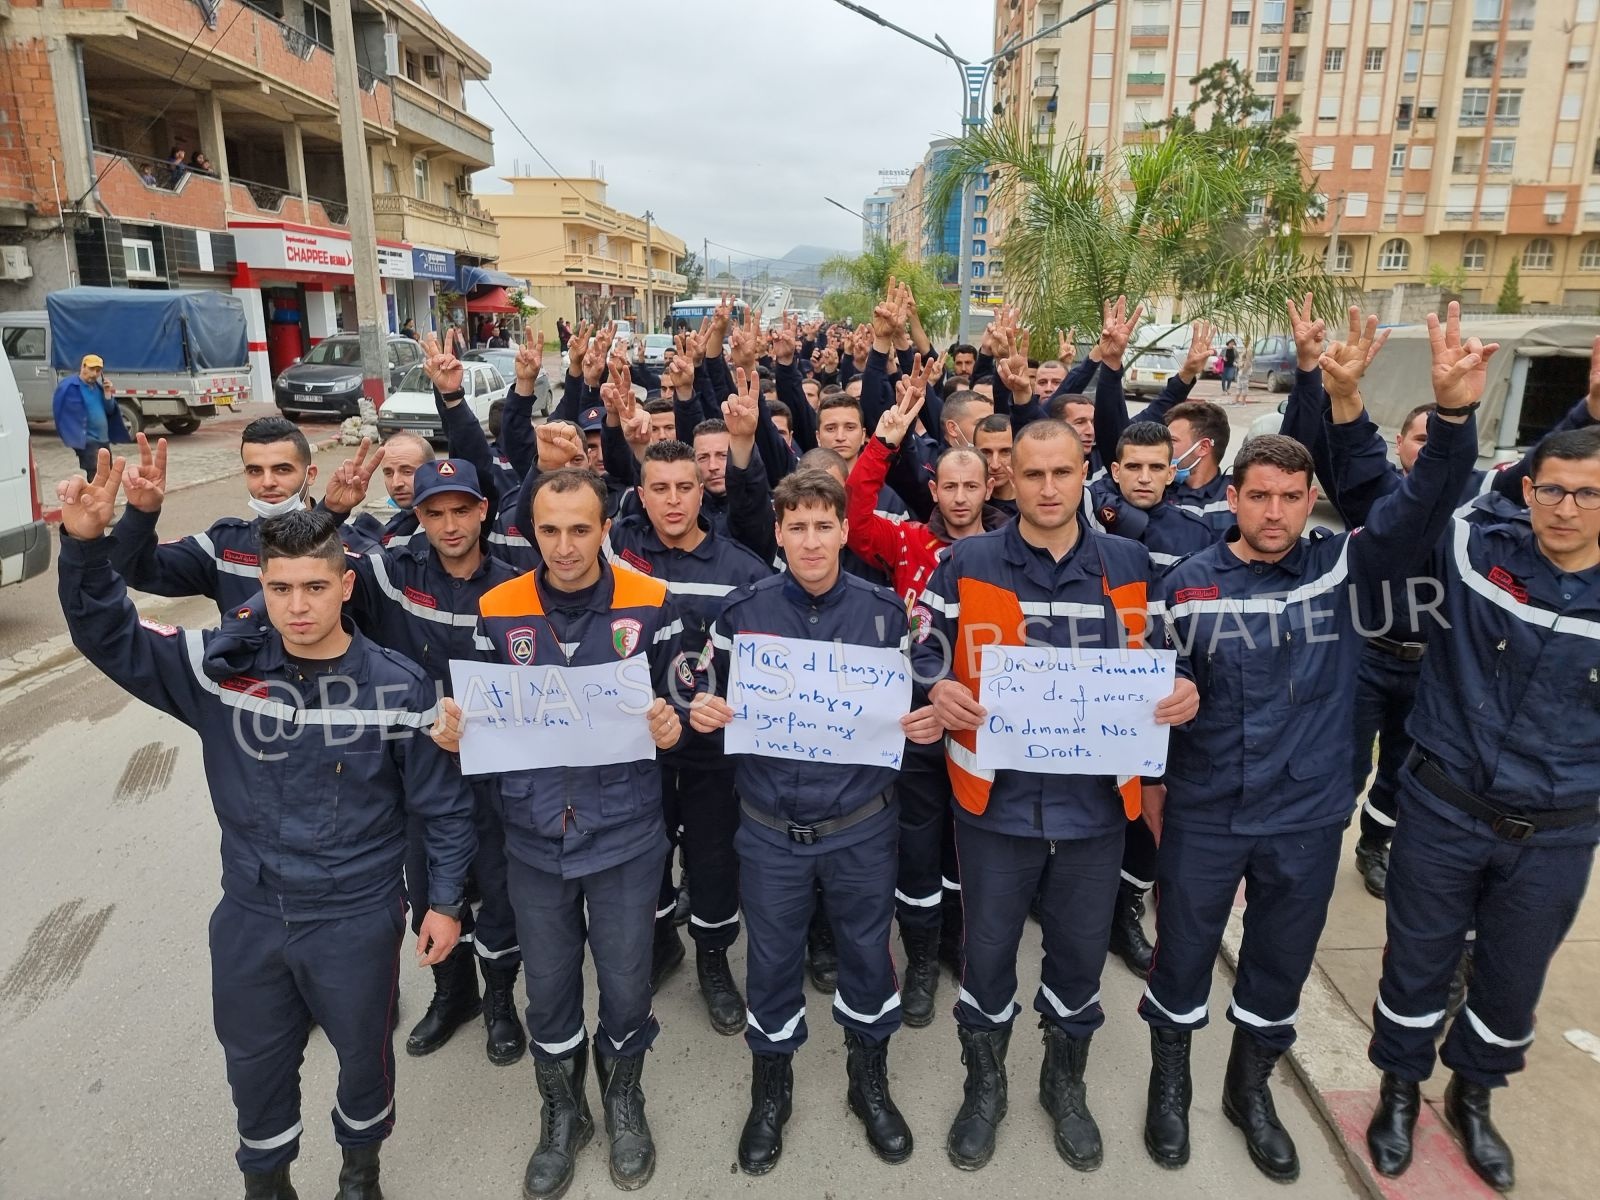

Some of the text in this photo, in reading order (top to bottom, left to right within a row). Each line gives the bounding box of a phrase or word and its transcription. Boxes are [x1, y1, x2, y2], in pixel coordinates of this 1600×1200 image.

[286, 246, 329, 265] CHAPPEE
[692, 308, 703, 316] VILLE
[802, 651, 816, 672] d
[1004, 655, 1167, 676] On vous demande
[582, 683, 619, 704] Pas
[989, 676, 1025, 698] Pas
[1043, 680, 1064, 702] de
[733, 704, 748, 720] d
[989, 715, 1138, 737] On demande Nos
